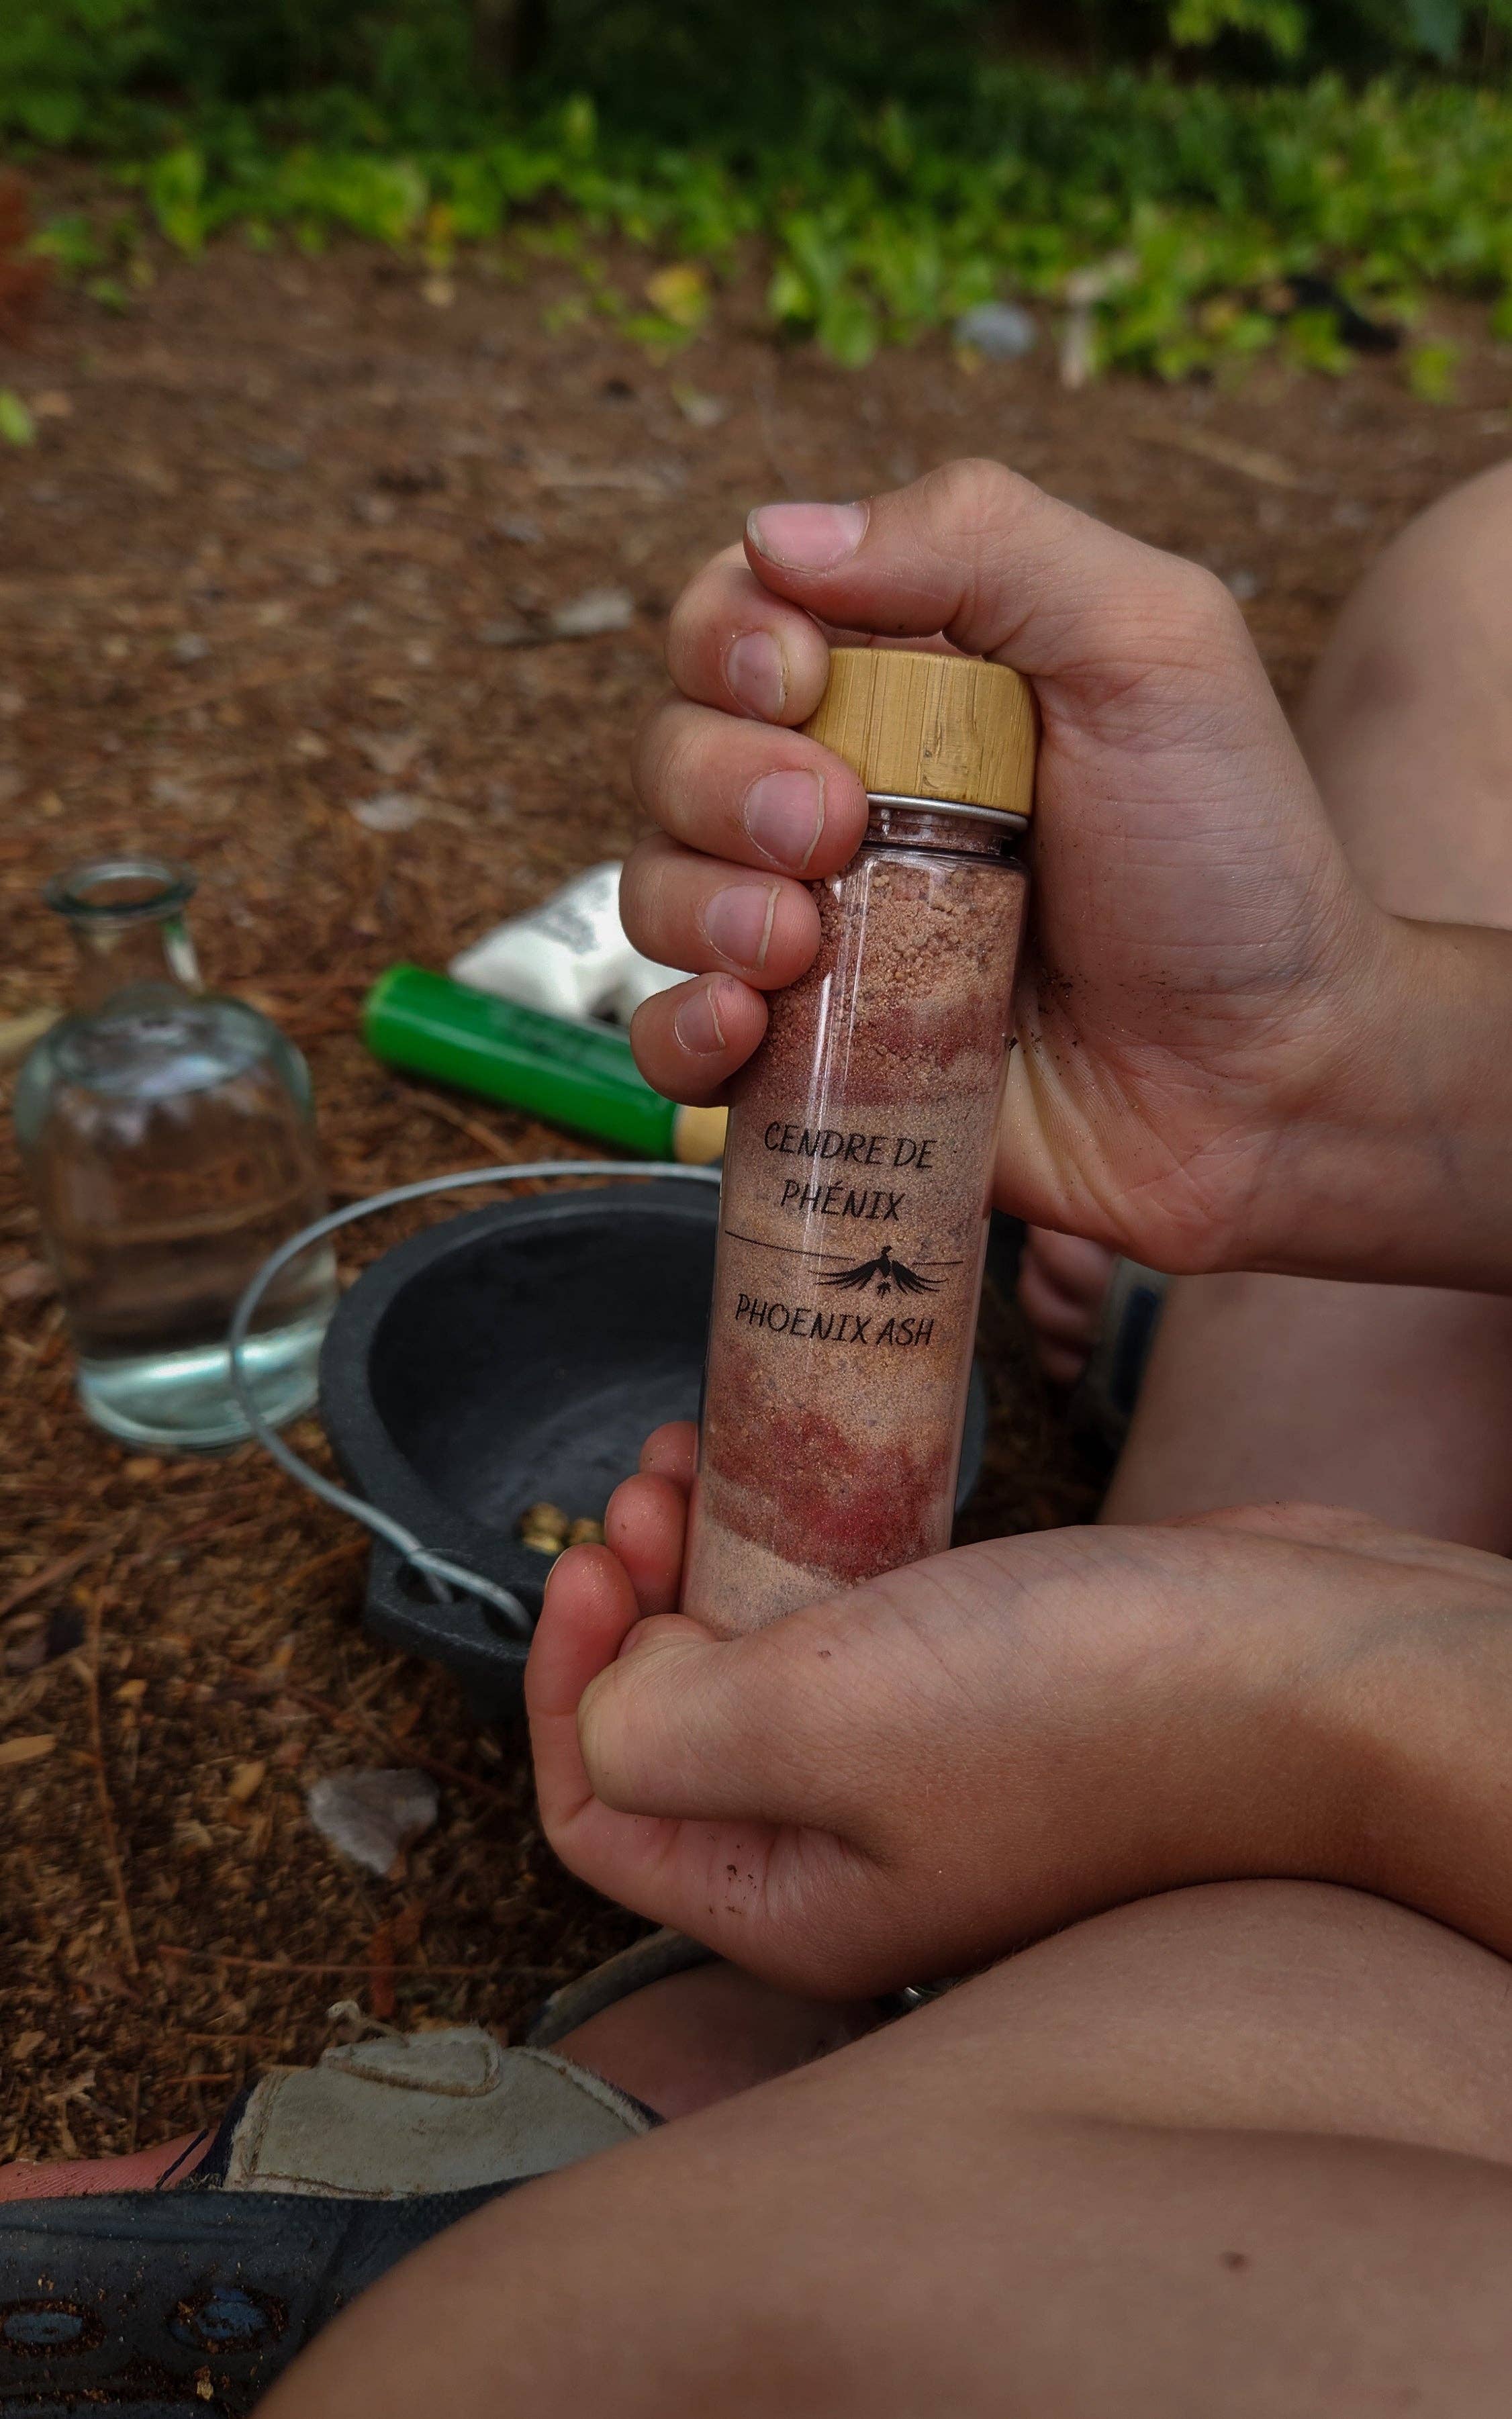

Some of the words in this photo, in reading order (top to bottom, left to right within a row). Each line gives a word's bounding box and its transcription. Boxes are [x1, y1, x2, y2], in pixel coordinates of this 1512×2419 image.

[764, 1121, 887, 1166] CENDRE
[894, 1138, 937, 1170] DE
[780, 1179, 906, 1221] PHÉNIX
[735, 1293, 873, 1345] PHOENIX
[876, 1317, 934, 1345] ASH
